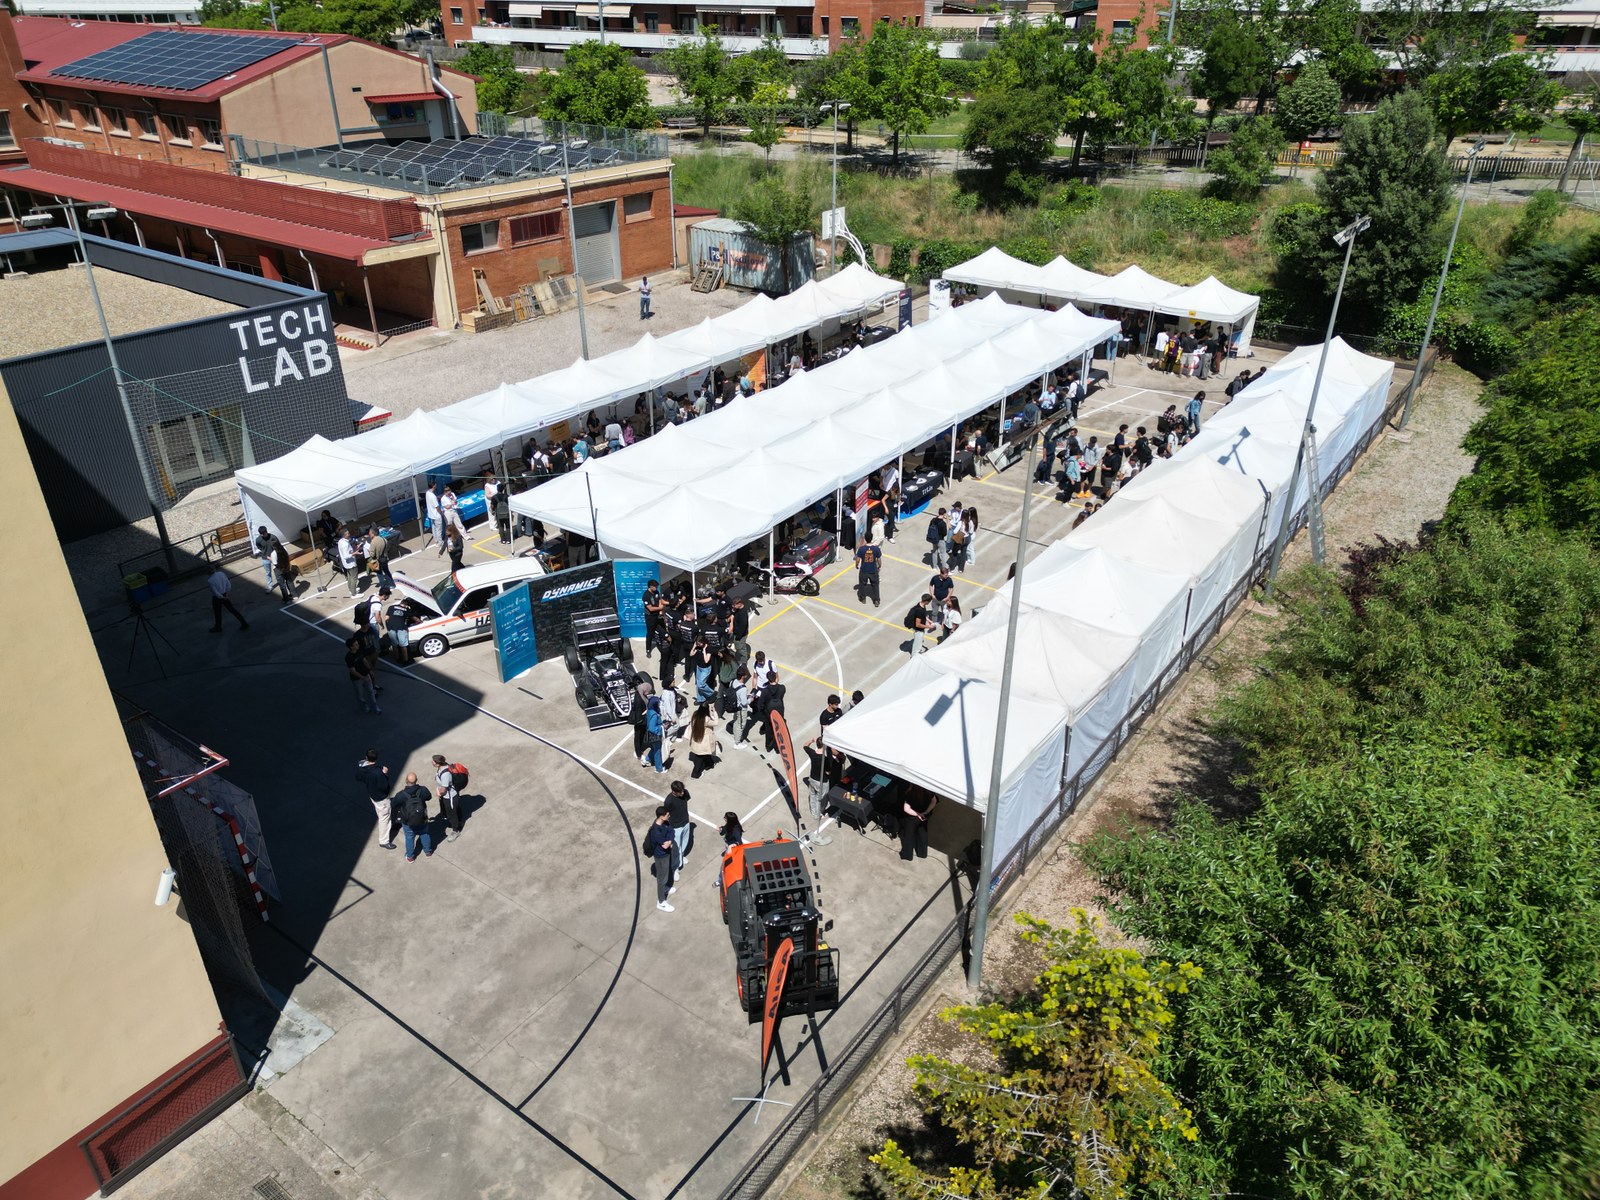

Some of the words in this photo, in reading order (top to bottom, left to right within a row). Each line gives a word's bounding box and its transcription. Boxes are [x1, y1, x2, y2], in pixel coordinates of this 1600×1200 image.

[229, 304, 327, 350] TECH
[239, 338, 333, 393] LAB
[542, 576, 604, 599] DYNAMICS
[607, 679, 625, 687] E25
